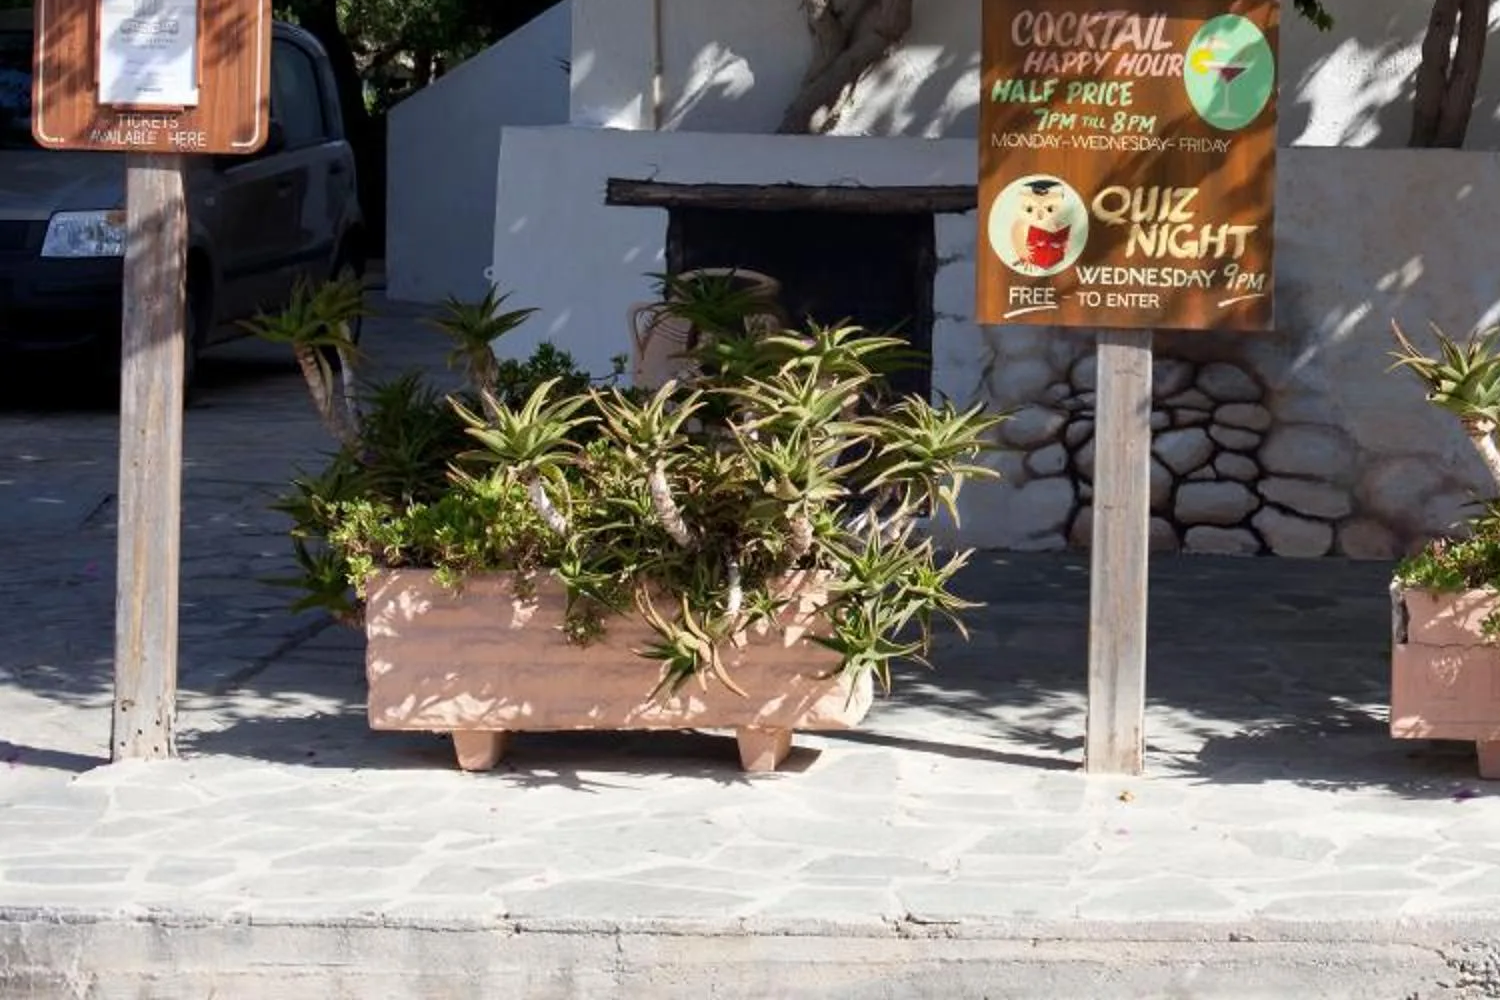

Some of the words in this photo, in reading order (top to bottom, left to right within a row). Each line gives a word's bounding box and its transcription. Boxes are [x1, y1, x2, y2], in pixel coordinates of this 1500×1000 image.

[1011, 10, 1173, 51] COCKTAIL
[1023, 50, 1112, 75] HAPPY
[1113, 52, 1184, 77] HOUR
[991, 78, 1058, 104] HALF
[1067, 80, 1134, 105] PRICE
[117, 114, 179, 129] TICKETS
[1034, 108, 1077, 131] 7PM
[1081, 116, 1105, 129] TILL
[1110, 110, 1157, 133] 8PM
[168, 131, 207, 147] HERE
[1092, 185, 1200, 225] QUIZ
[1125, 223, 1258, 259] NIGHT
[1076, 265, 1216, 288] WEDNESDAY
[1223, 264, 1265, 290] 9PM
[1009, 287, 1056, 305] FREE
[1077, 290, 1100, 307] TO
[1107, 292, 1159, 308] ENTER
